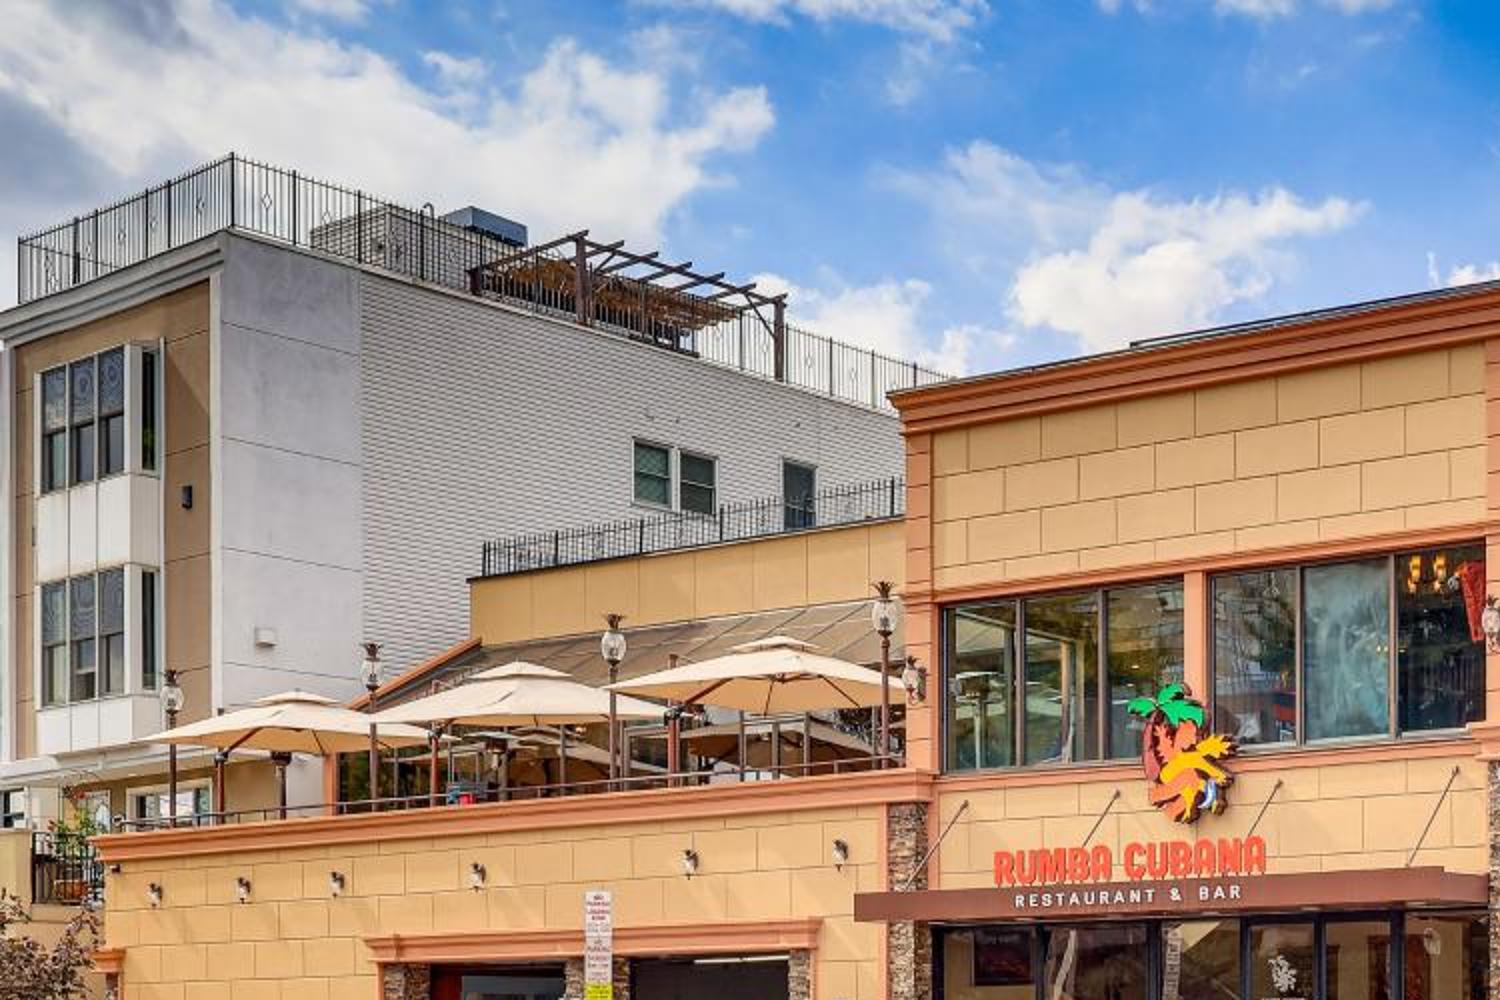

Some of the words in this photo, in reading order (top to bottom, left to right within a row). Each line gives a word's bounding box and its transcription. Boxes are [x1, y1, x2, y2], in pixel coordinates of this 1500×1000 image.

[993, 845, 1112, 887] RUMBA
[1123, 836, 1267, 880] CUBANA
[1015, 889, 1155, 908] RESTAURANT
[1170, 887, 1182, 900] &
[1199, 885, 1241, 900] BAR
